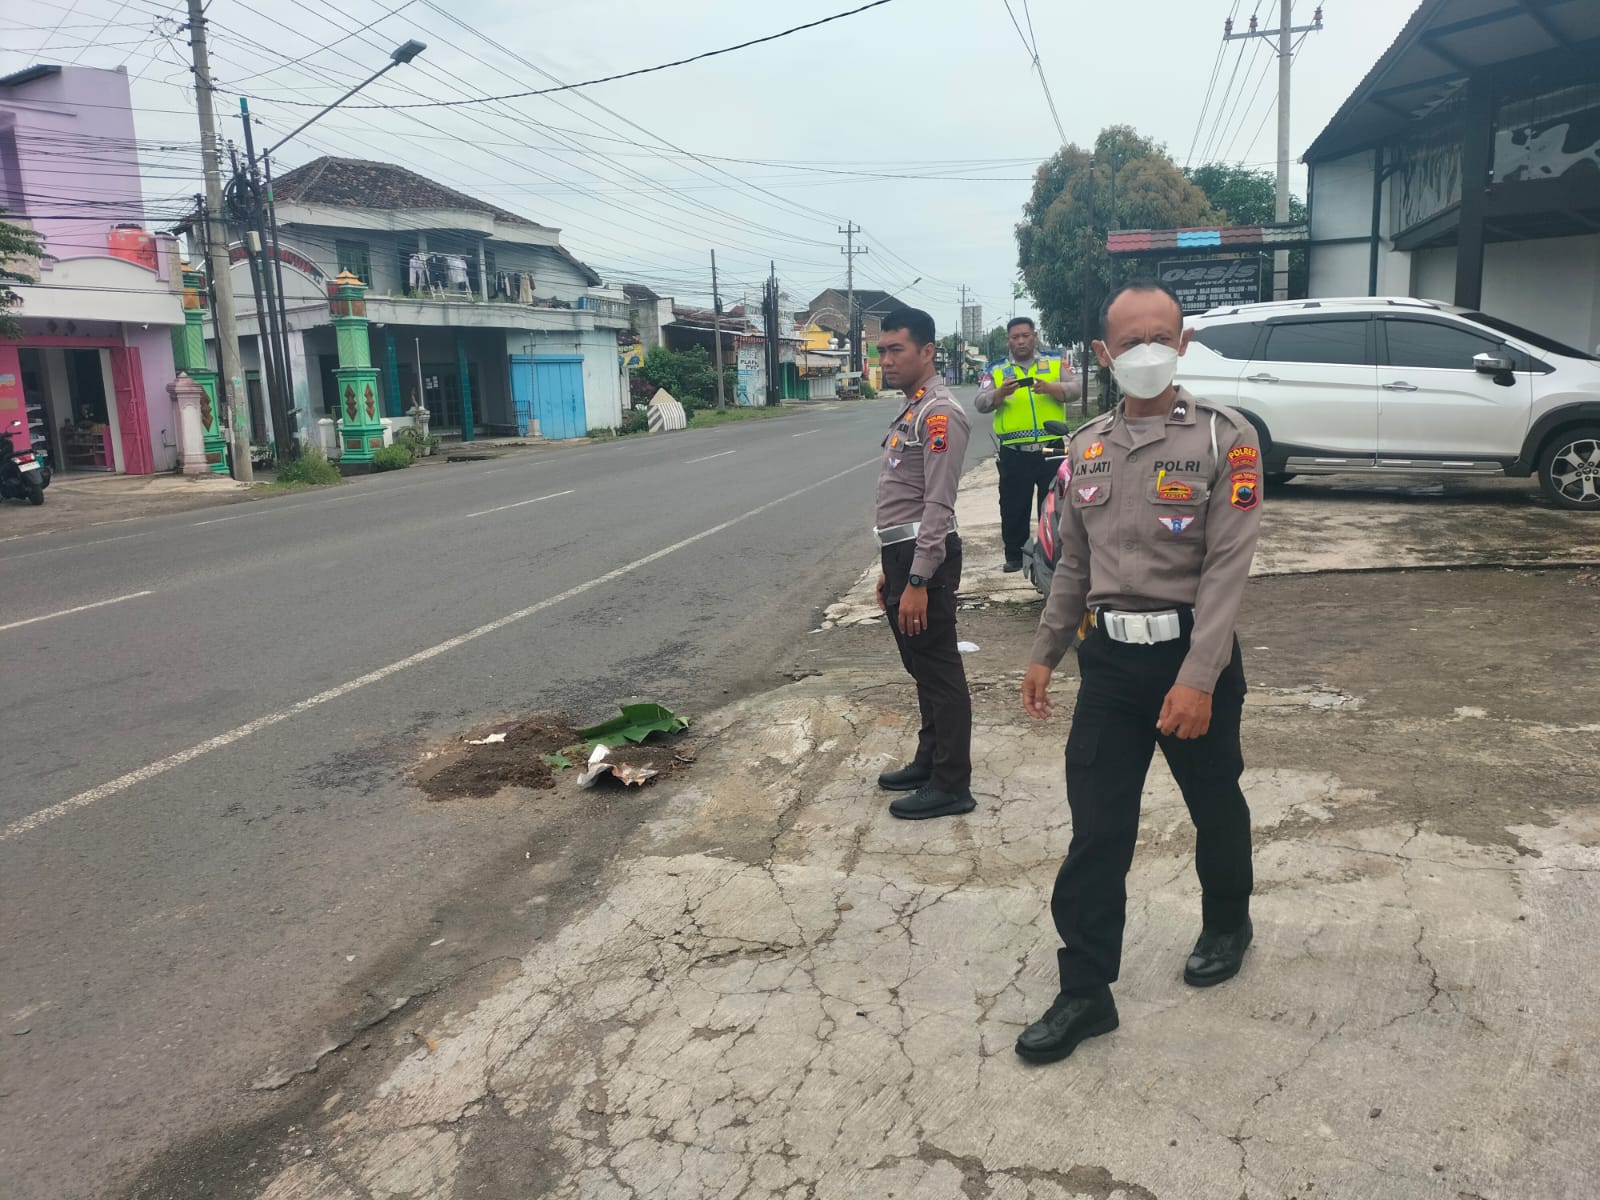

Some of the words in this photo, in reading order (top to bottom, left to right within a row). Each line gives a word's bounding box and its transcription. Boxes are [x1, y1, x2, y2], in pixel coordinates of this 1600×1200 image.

[1161, 260, 1258, 282] oasis
[1228, 447, 1257, 459] POLRES
[1089, 461, 1111, 474] JATI
[1153, 460, 1200, 473] POLRI
